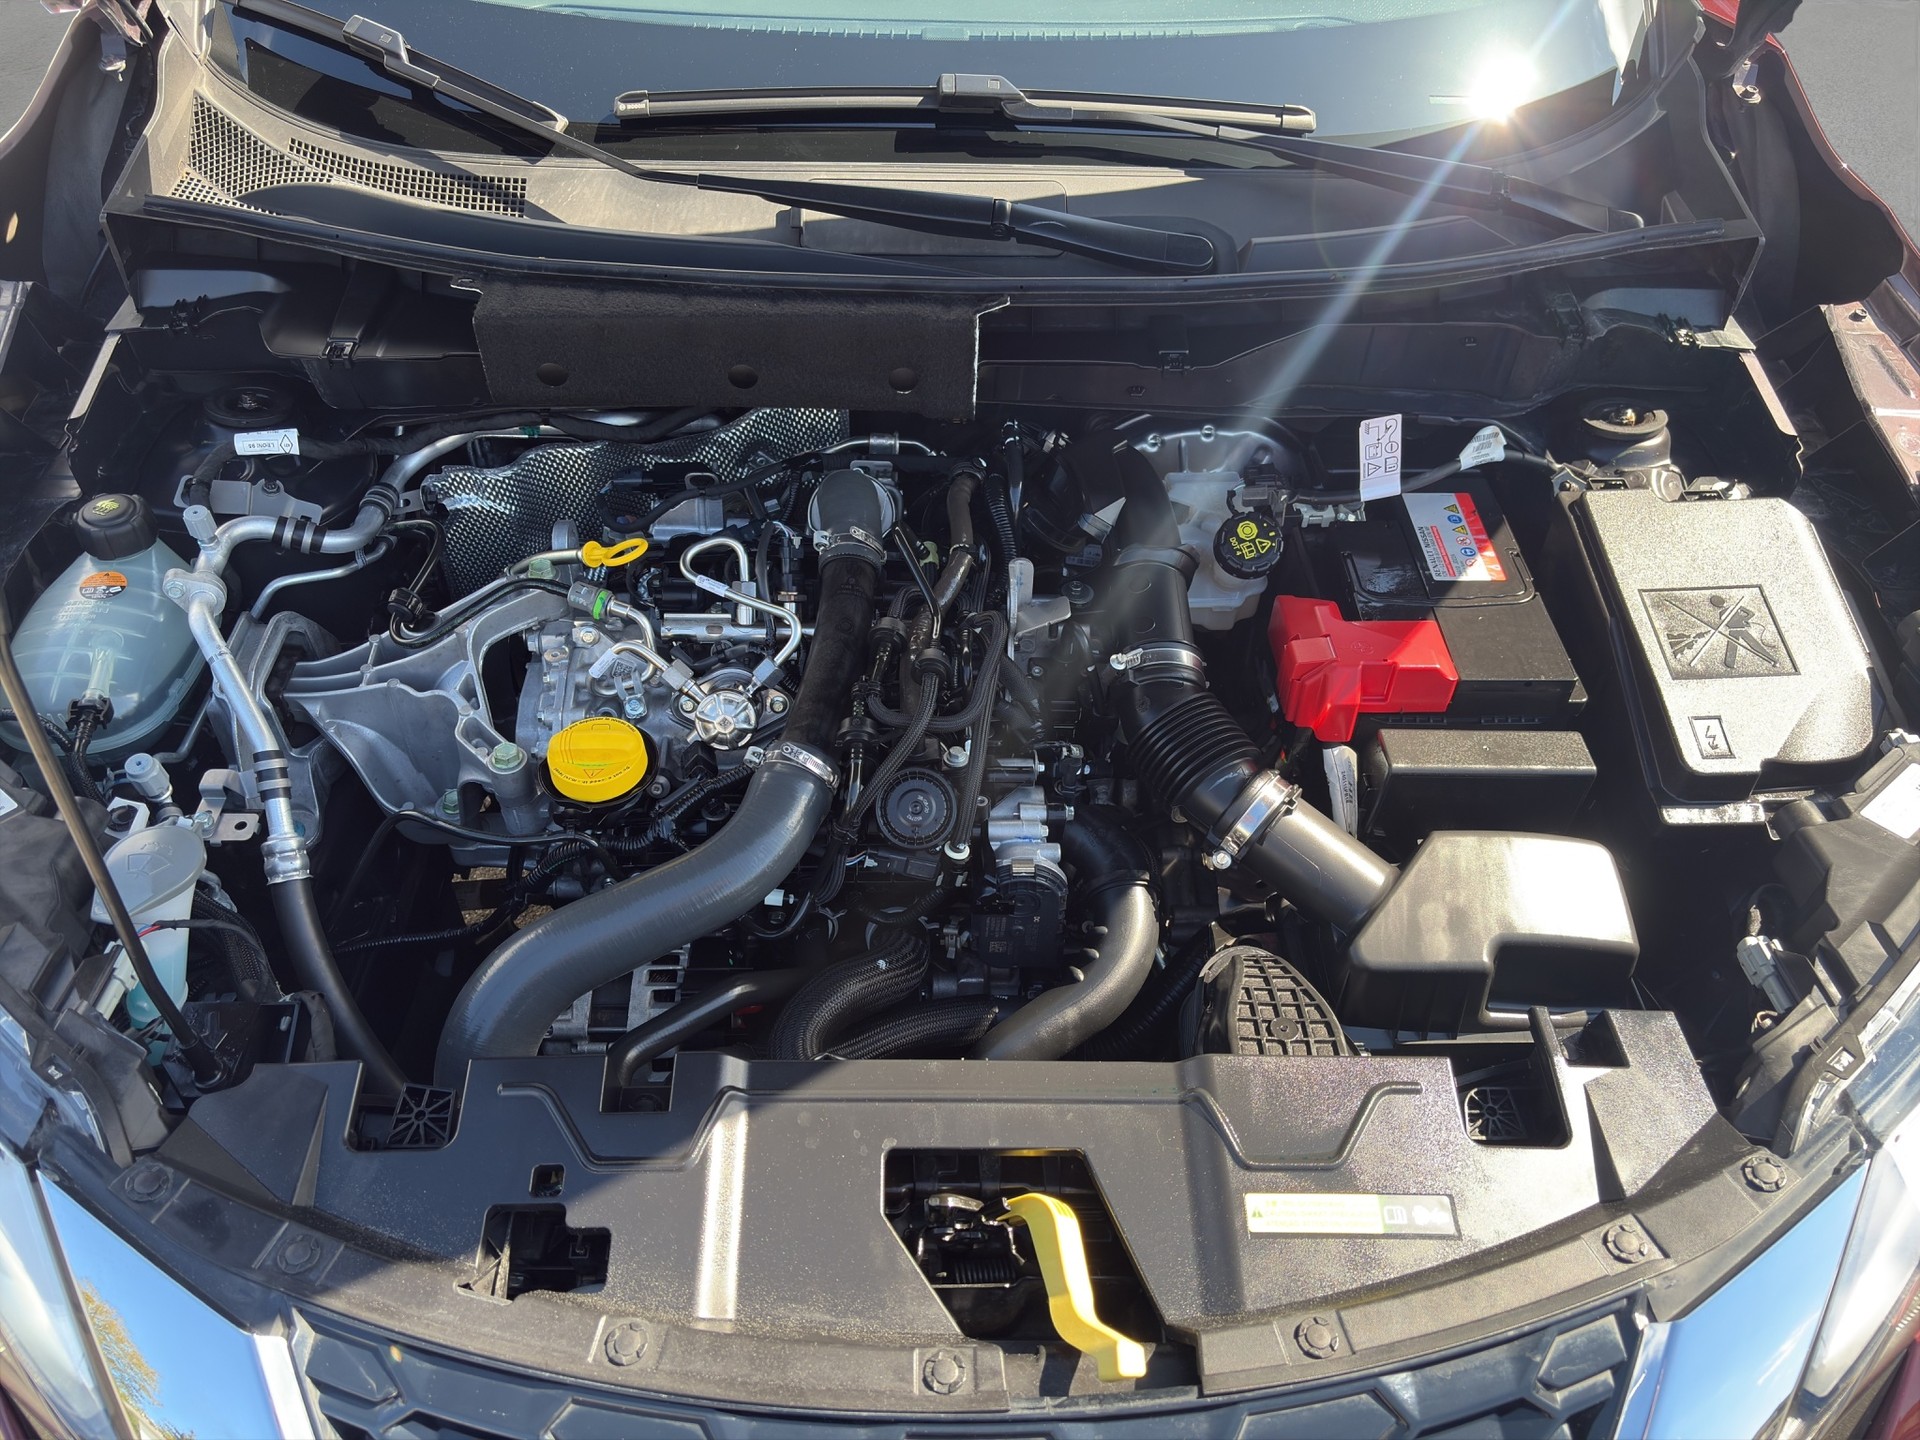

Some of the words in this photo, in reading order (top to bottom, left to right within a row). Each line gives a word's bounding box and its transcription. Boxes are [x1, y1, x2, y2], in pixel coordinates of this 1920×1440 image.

[1229, 537, 1240, 550] DOT
[1417, 526, 1431, 549] NISSAN
[1426, 550, 1441, 577] RENAULT
